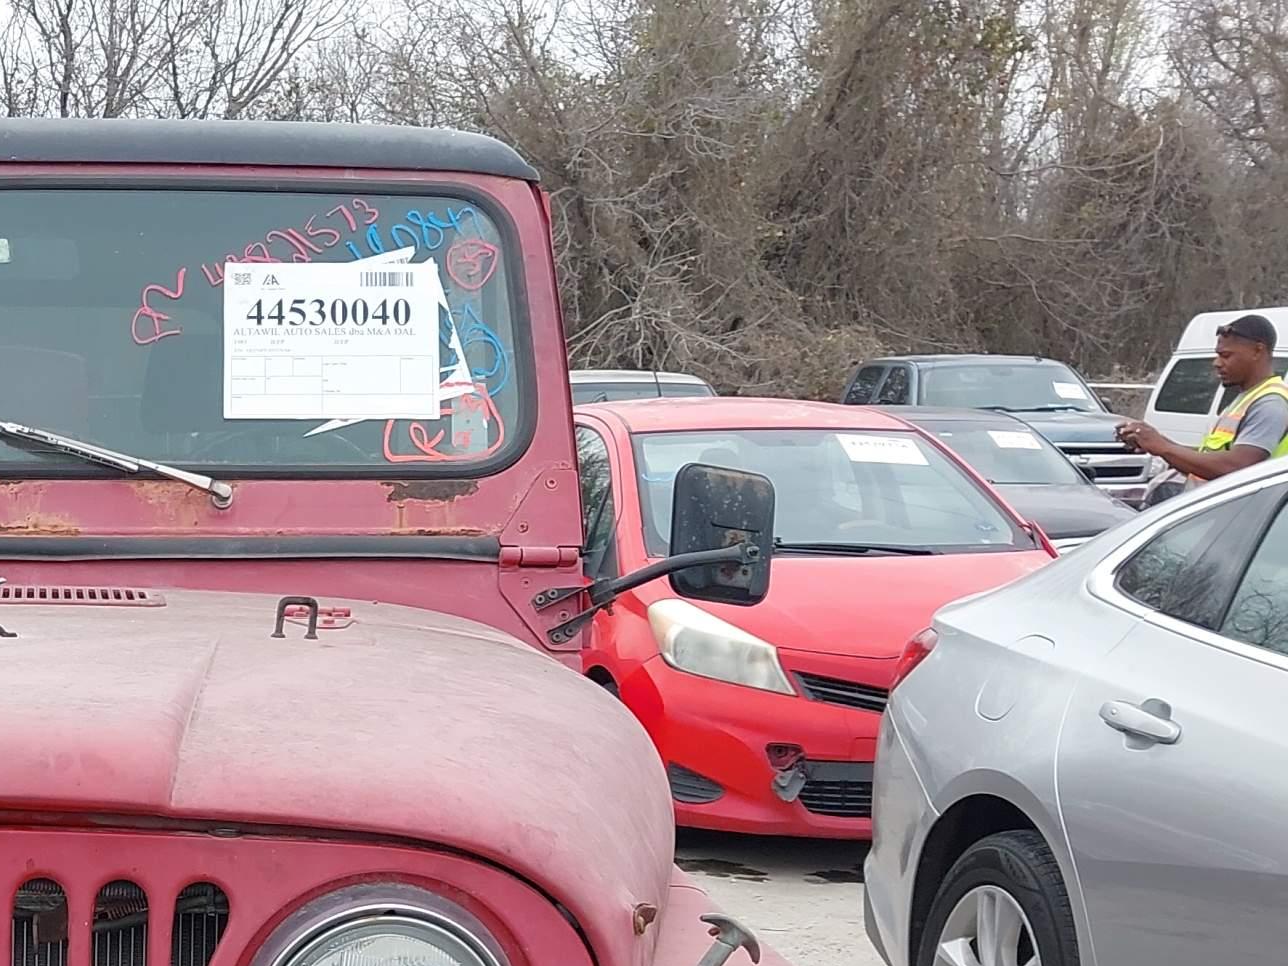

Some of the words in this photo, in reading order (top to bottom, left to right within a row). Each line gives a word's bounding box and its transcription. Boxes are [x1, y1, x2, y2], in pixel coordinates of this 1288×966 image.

[246, 298, 411, 326] 44530040
[233, 327, 280, 336] ALTAWIL
[283, 327, 312, 336] AUTO
[314, 327, 346, 336] SALES
[348, 327, 364, 336] dba
[367, 327, 391, 336] M&A
[394, 327, 416, 336] DAL
